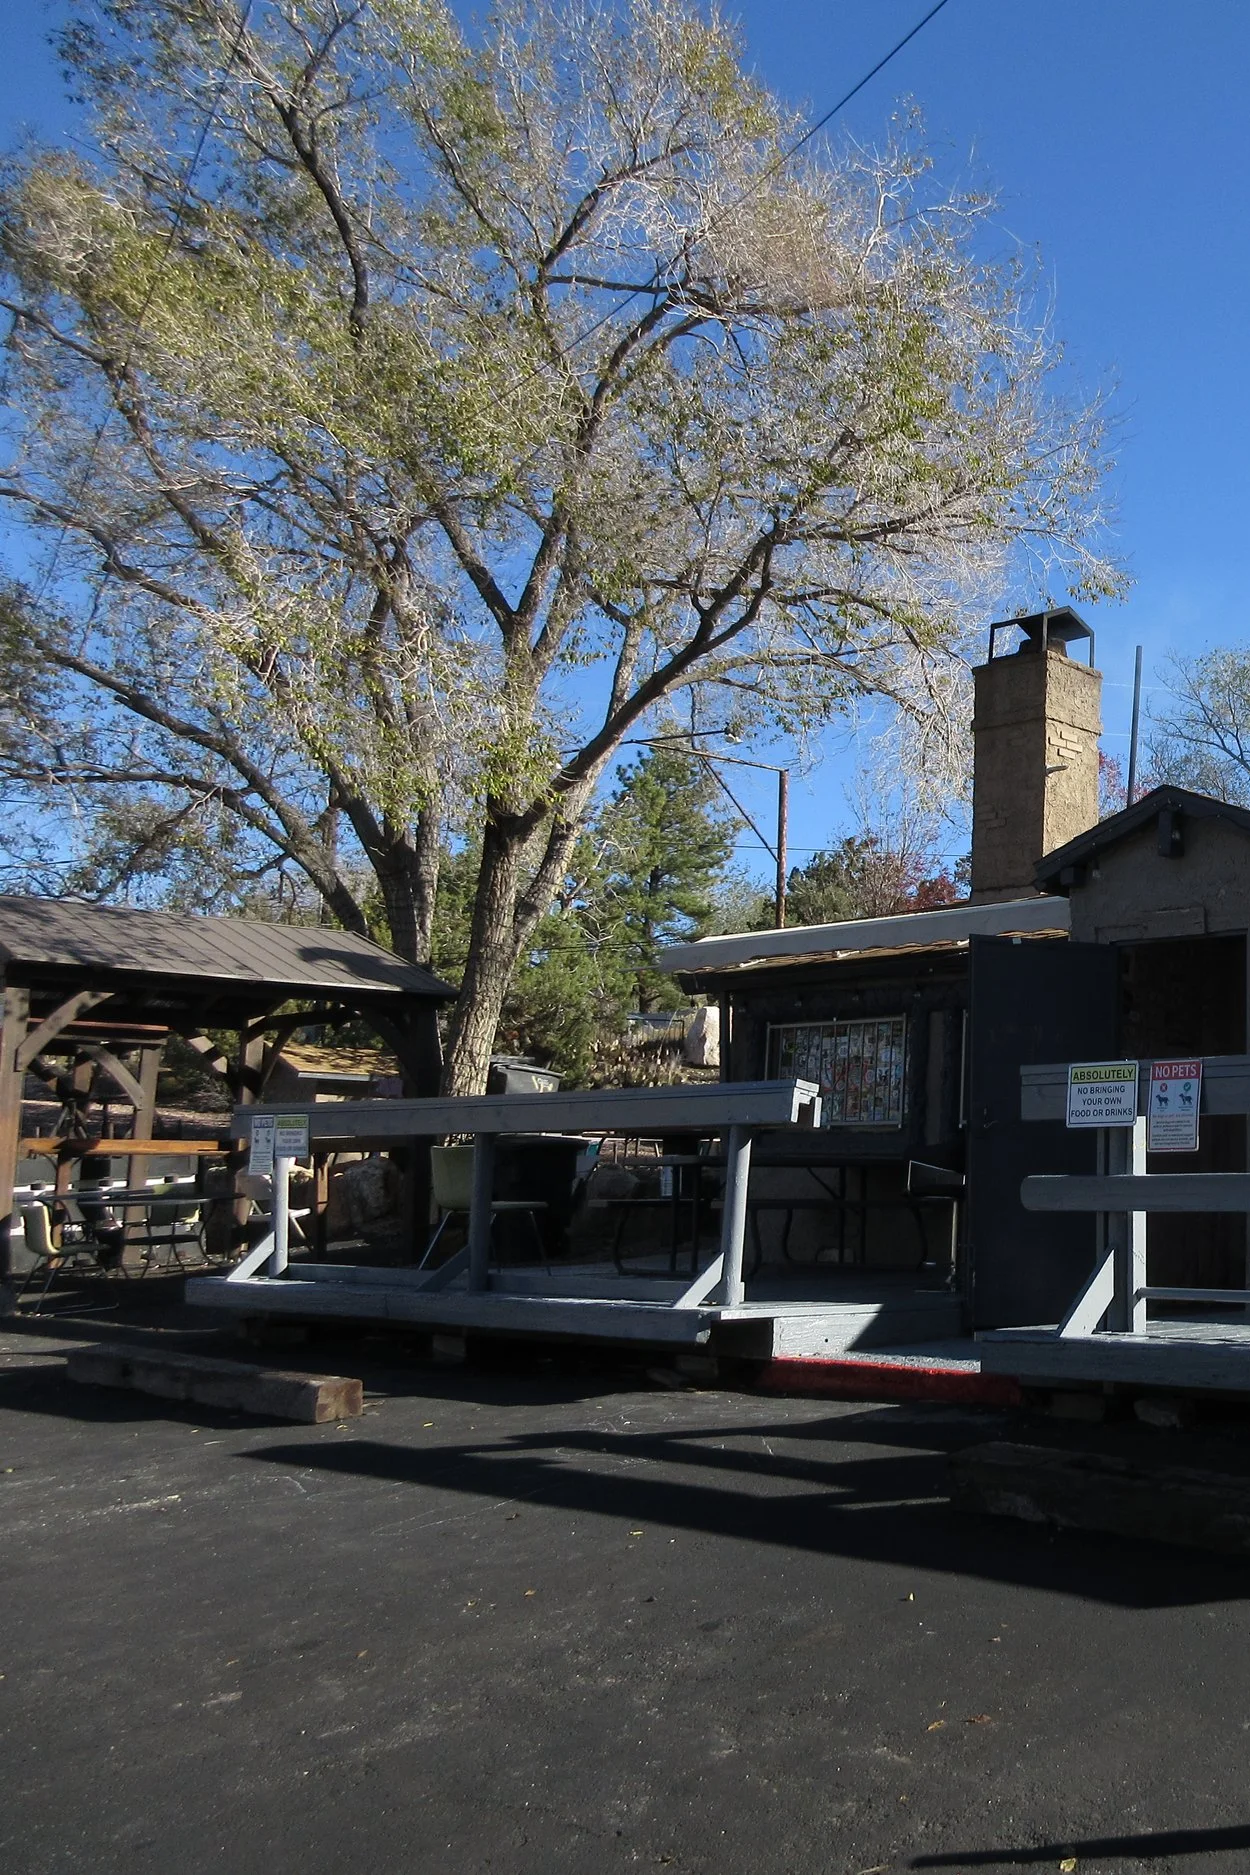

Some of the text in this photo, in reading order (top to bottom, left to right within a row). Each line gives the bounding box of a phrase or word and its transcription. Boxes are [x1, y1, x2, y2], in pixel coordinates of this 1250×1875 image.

[1073, 1069, 1134, 1081] ABSOLUTELY
[1155, 1064, 1197, 1078] NO PETS
[1077, 1085, 1126, 1095] NO BRINGING
[1082, 1097, 1122, 1105] YOUR OWN
[1071, 1109, 1091, 1117] FOOD
[1105, 1108, 1133, 1116] DRINKS
